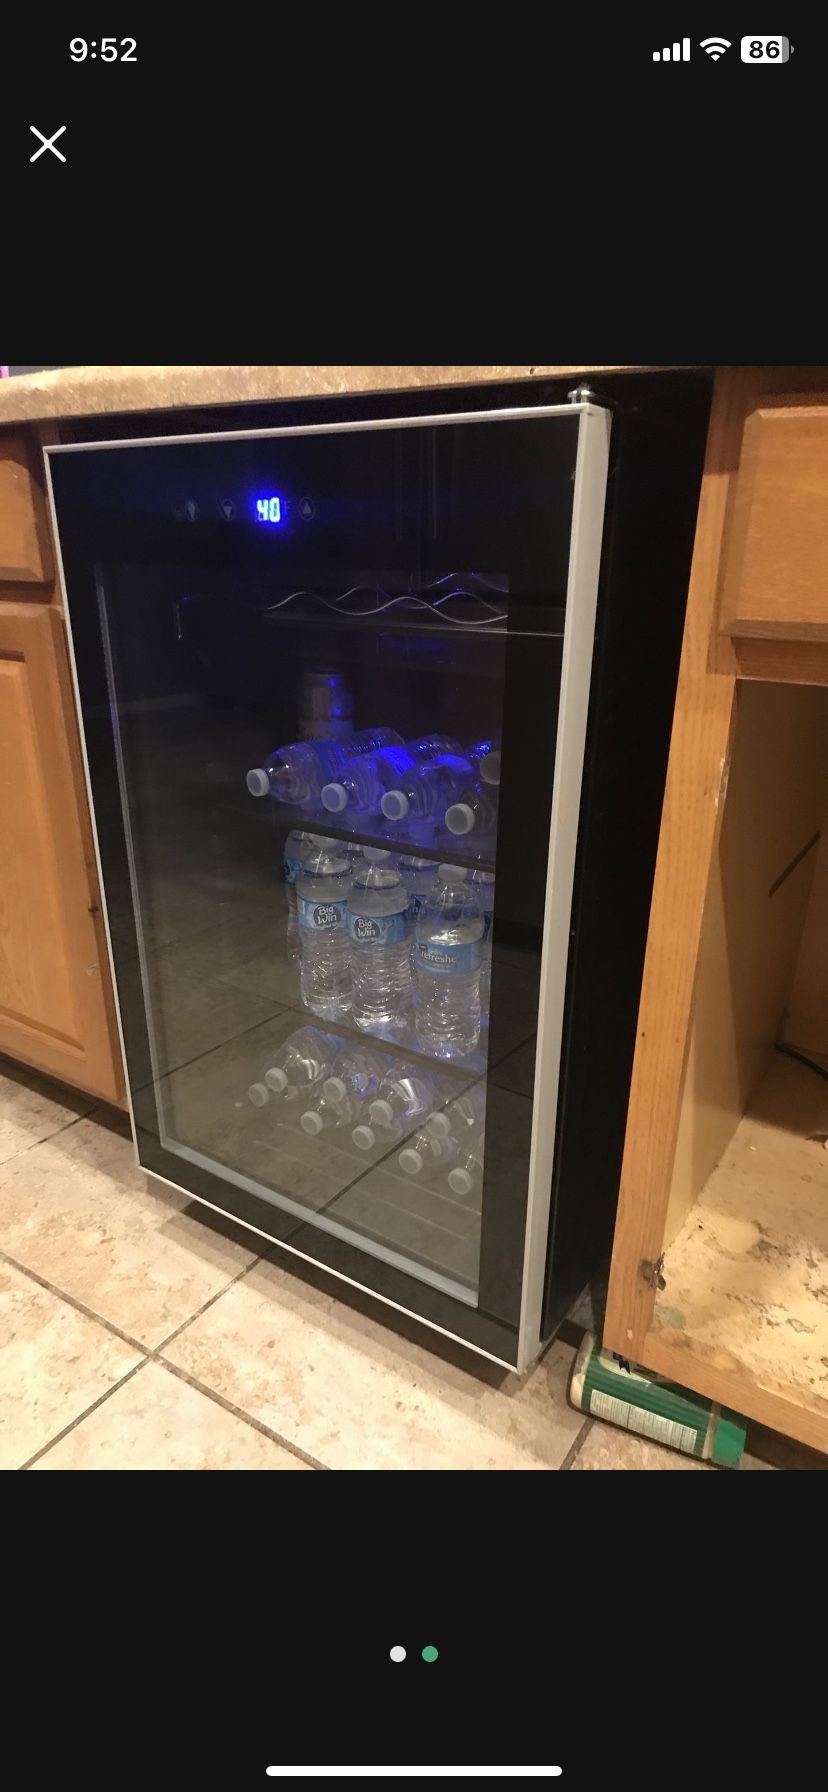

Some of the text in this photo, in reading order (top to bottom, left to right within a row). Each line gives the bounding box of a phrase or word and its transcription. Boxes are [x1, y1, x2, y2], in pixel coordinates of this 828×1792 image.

[257, 496, 281, 523] 40
[317, 905, 334, 916] Big
[317, 913, 337, 925] Win
[358, 918, 373, 930] Big
[357, 927, 376, 938] Win
